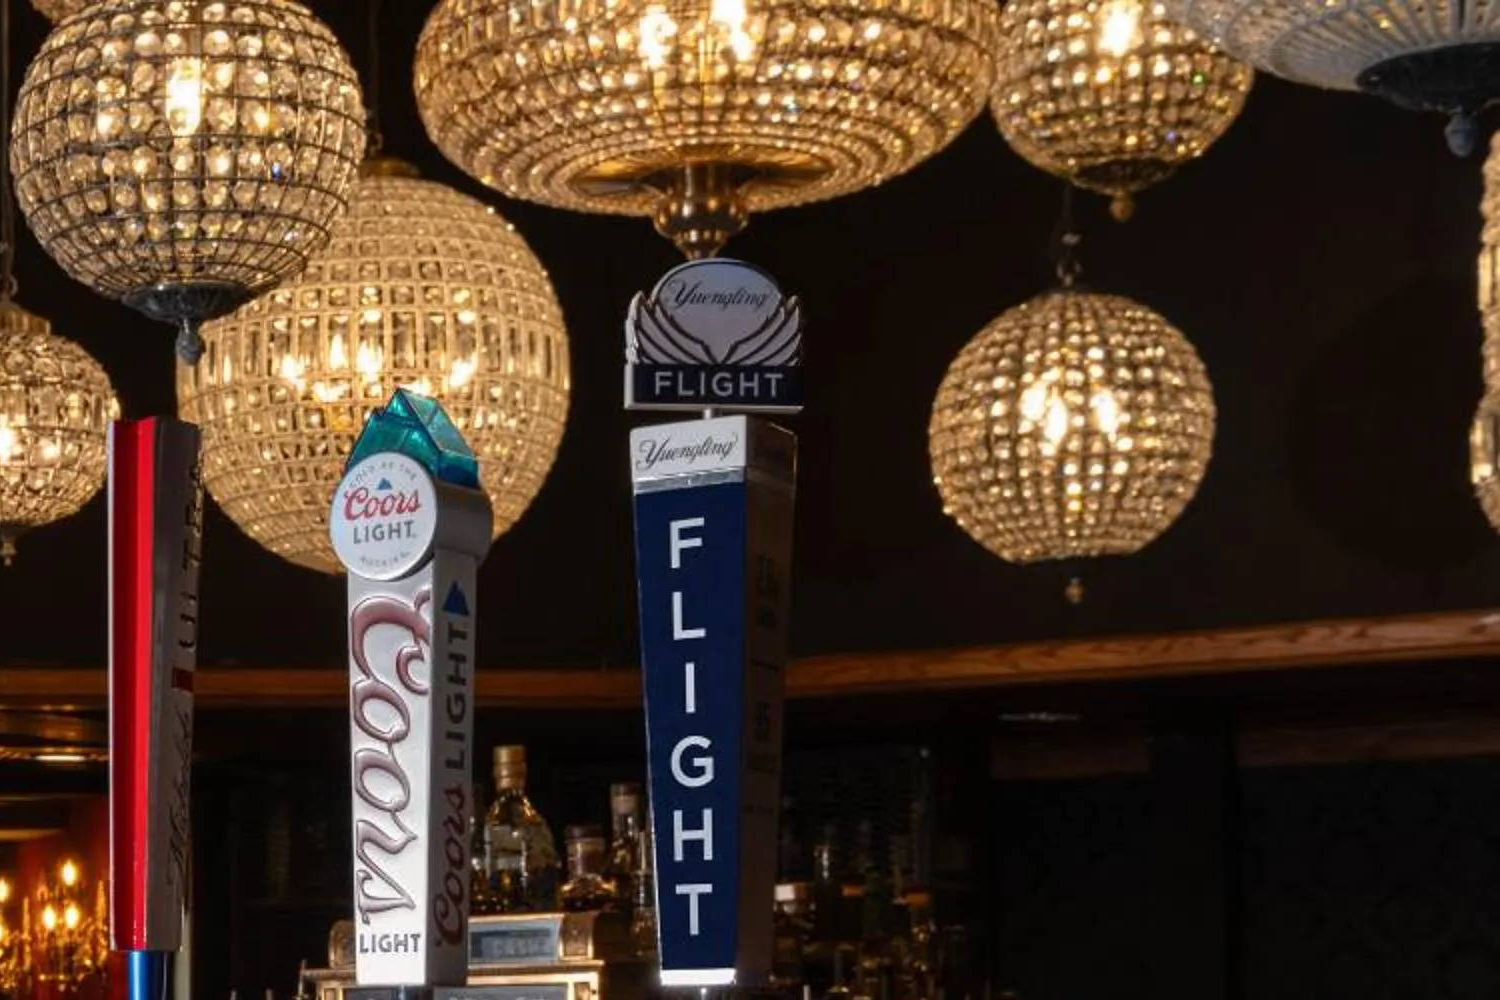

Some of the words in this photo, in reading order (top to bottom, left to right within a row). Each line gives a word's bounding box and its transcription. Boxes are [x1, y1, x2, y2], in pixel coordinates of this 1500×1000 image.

[668, 279, 769, 310] Yuengling
[654, 371, 785, 398] FLIGHT
[635, 433, 739, 472] Yuengling
[343, 486, 422, 521] Coors
[353, 520, 415, 544] LIGHT
[446, 622, 469, 771] LIGHT
[668, 516, 716, 937] FLIGHT
[351, 585, 431, 925] Coors
[434, 782, 470, 948] Coors
[358, 932, 422, 954] LIGHT
